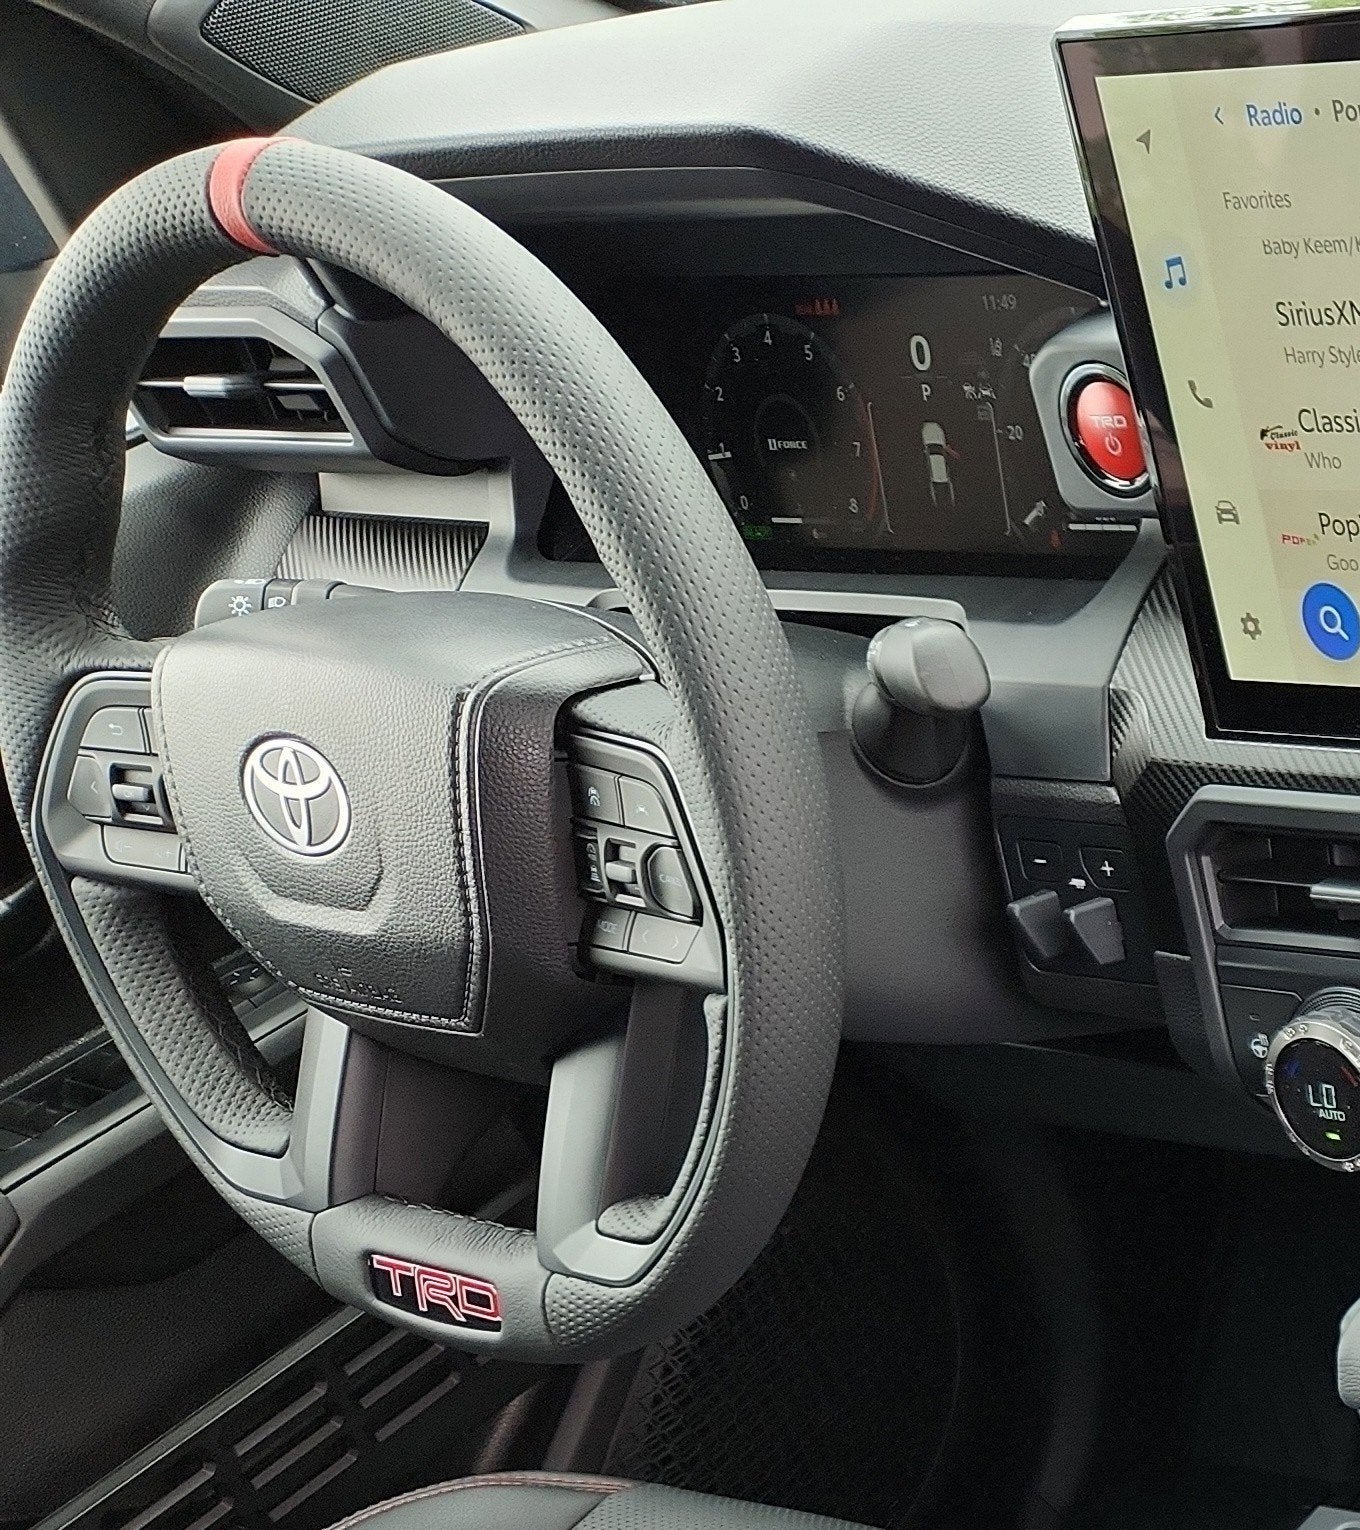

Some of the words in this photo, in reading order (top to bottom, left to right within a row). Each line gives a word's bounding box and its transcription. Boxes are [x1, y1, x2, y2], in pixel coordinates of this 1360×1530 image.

[1246, 103, 1303, 127] Radio
[1223, 191, 1292, 211] Favorites
[804, 345, 813, 361] 5
[910, 334, 931, 371] 0
[1284, 346, 1324, 368] Harry
[836, 386, 845, 401] 6
[922, 383, 931, 401] P
[1089, 414, 1127, 429] TRD
[1304, 452, 1342, 471] Who
[1327, 554, 1358, 573] Goo
[1307, 1084, 1337, 1109] LO
[1318, 1109, 1346, 1122] AUTO
[371, 1255, 503, 1322] TRD
